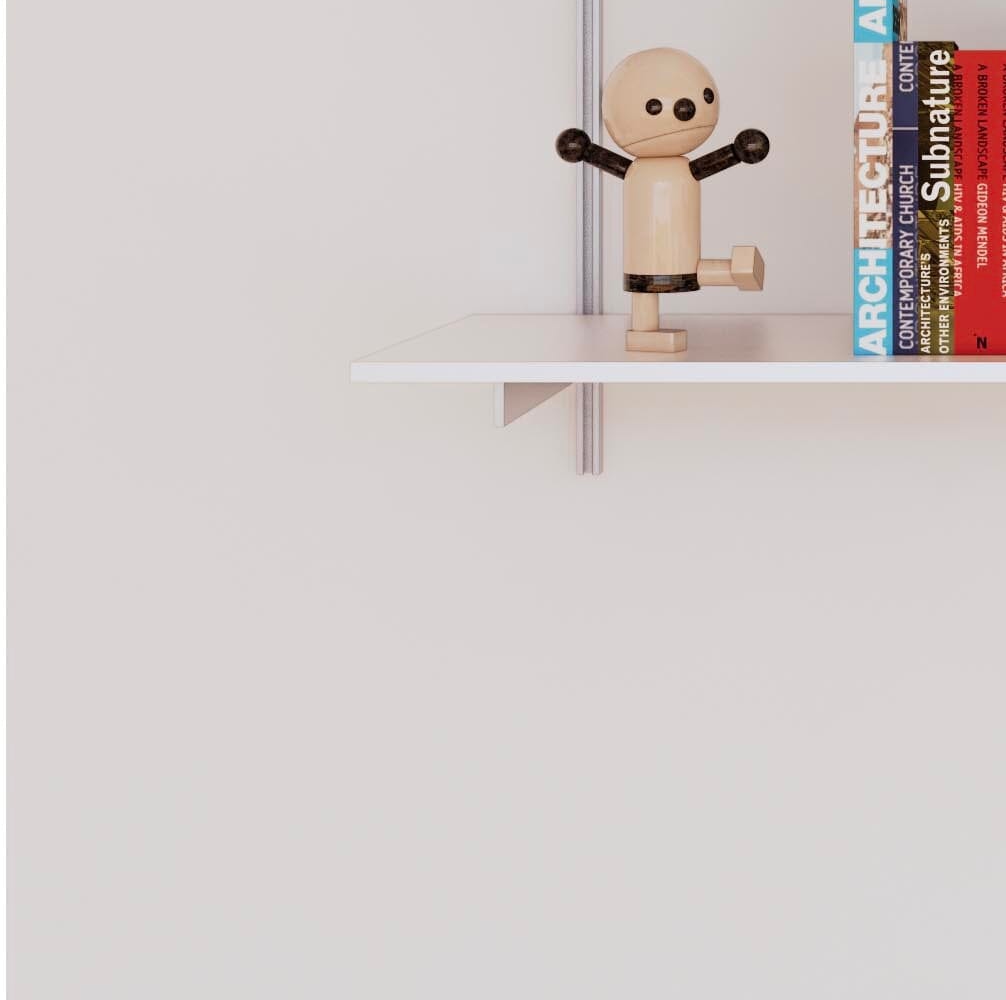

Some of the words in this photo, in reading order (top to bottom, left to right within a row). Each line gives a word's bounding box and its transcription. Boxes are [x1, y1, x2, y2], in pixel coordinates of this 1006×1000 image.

[899, 41, 914, 93] CONTE
[977, 64, 988, 72] A
[977, 74, 988, 117] BROKEN
[920, 49, 951, 203] Subnature
[977, 120, 988, 181] LANDSCAPE
[857, 60, 888, 356] ARCHITECTURE
[899, 165, 914, 225] CHURCH
[977, 183, 988, 224] GIDEON
[939, 219, 950, 311] ENVIRONMENTS
[977, 227, 988, 269] MENDEL
[899, 230, 914, 350] CONTEMPORARY
[920, 253, 931, 354] ARCHITECTURE'S
[939, 315, 950, 354] OTHER
